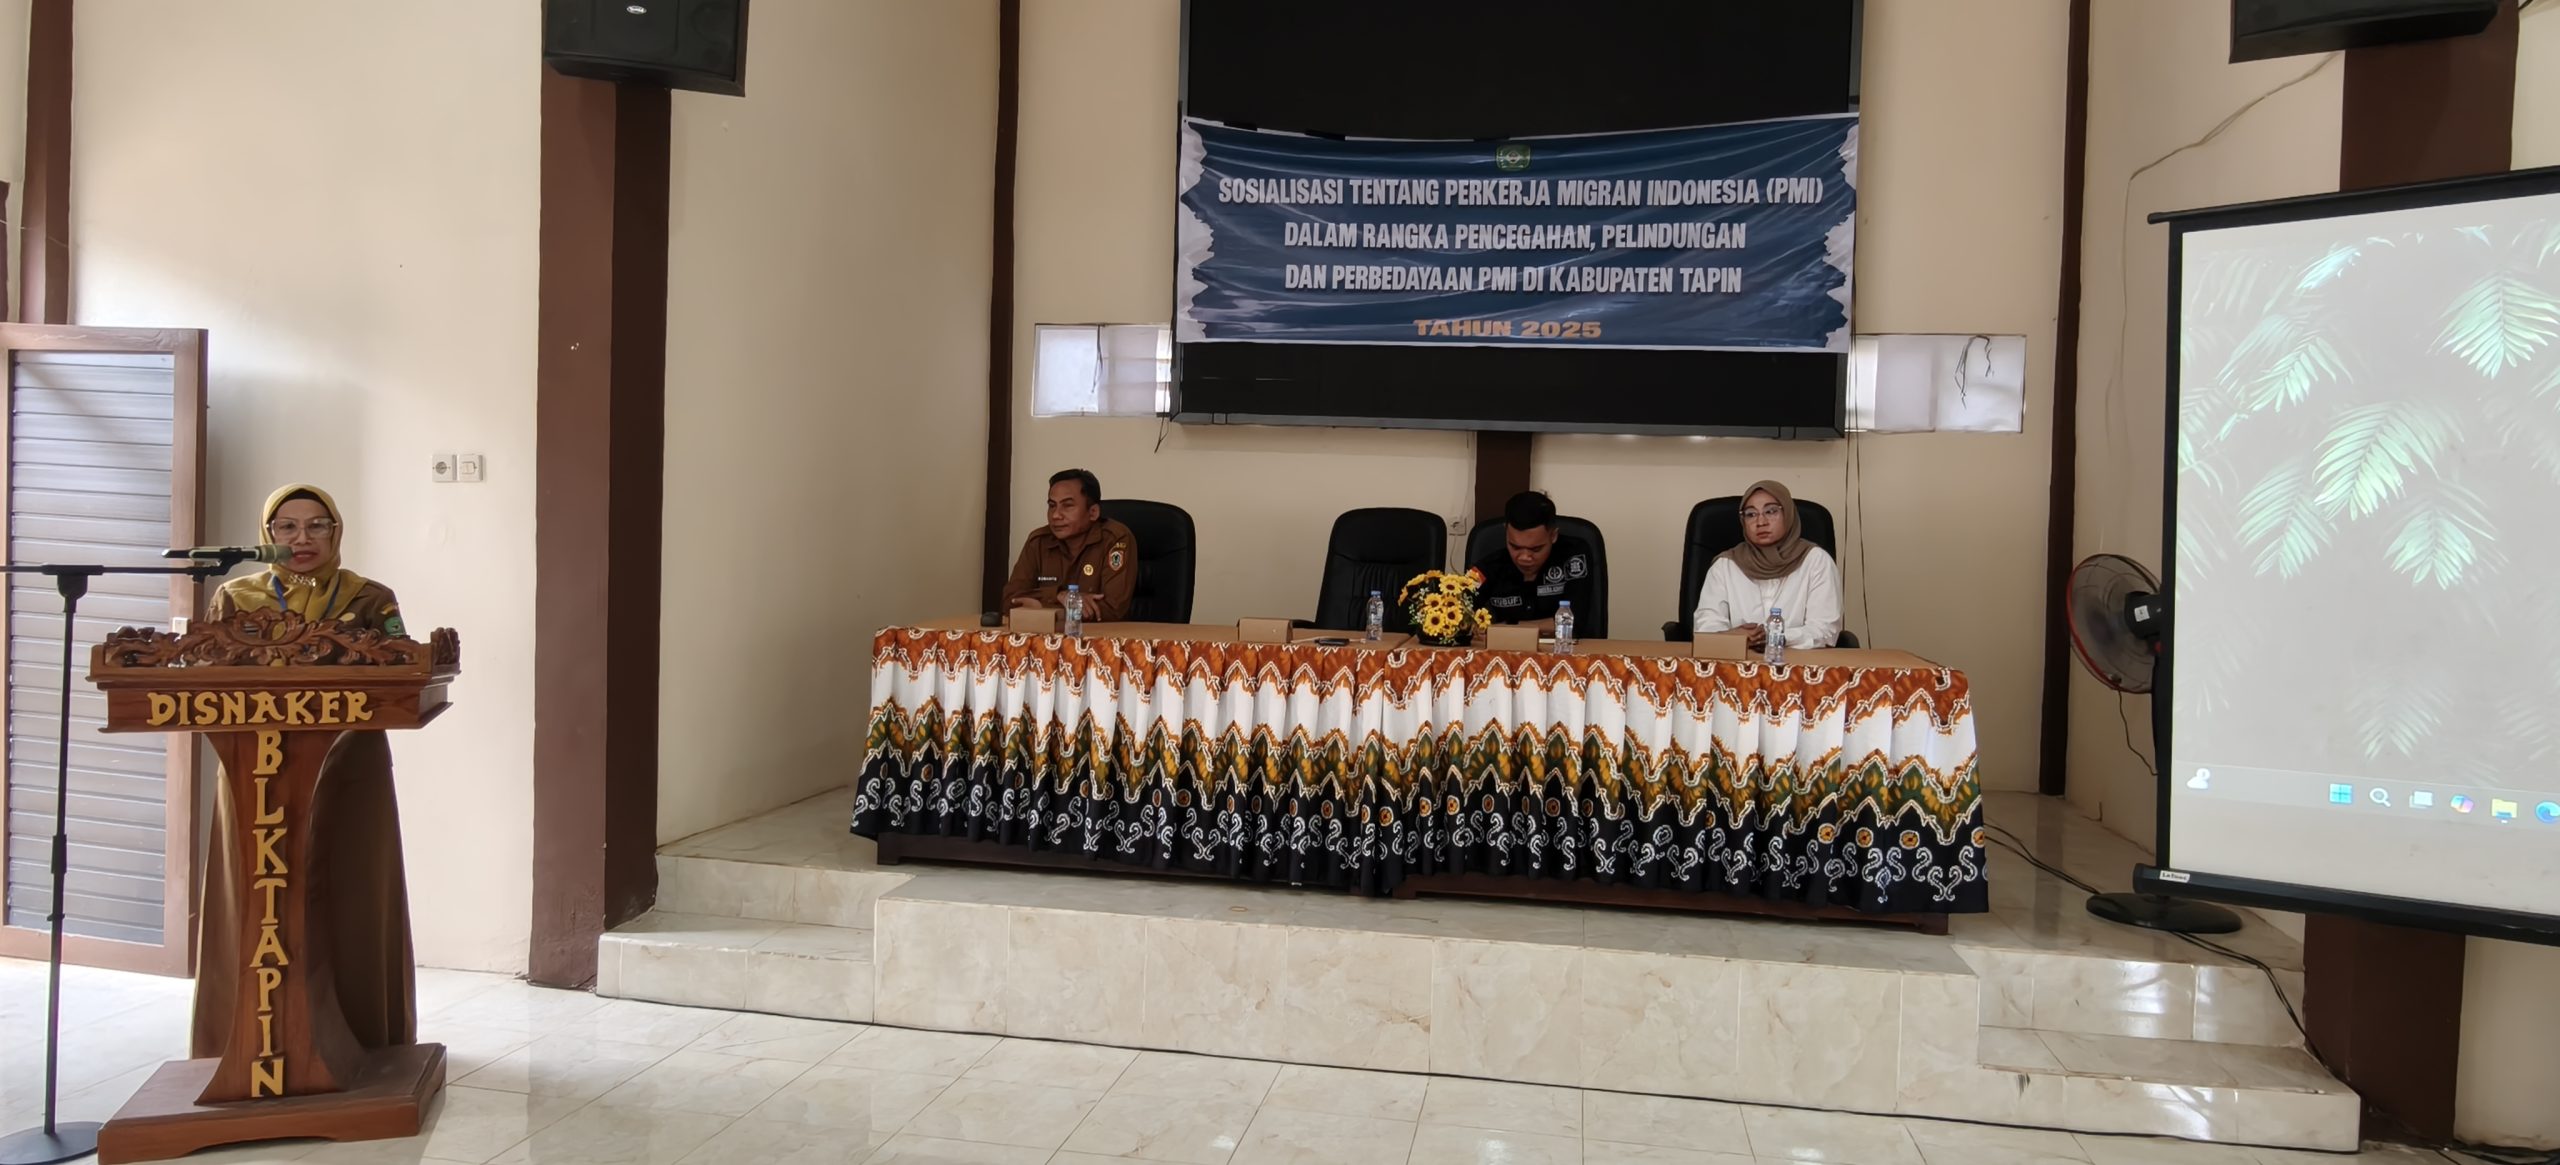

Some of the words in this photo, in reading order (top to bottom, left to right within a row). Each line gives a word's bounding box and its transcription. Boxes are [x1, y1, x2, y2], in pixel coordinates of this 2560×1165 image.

[1219, 178, 1343, 205] SOSIALISASI
[1349, 179, 1439, 205] TENTANG
[1445, 179, 1550, 206] PERKERJA
[1557, 179, 1642, 206] MIGRAN
[1647, 178, 1760, 206] INDONESIA
[1766, 177, 1824, 204] (PMI)
[1284, 222, 1357, 248] DALAM
[1362, 223, 1449, 250] RANGKA
[1455, 223, 1596, 251] PENCEGAHAN,
[1602, 222, 1747, 249] PELINDUNGAN
[1285, 264, 1327, 290] DAN
[1332, 265, 1473, 291] PERBEDAYAAN
[1478, 266, 1517, 291] PMI
[1522, 266, 1544, 292] DI
[1550, 266, 1673, 293] KABUPATEN
[1680, 267, 1742, 293] TAPIN
[1413, 319, 1513, 337] TAHUN
[1520, 321, 1602, 338] 2025
[146, 690, 373, 727] DISNAKER
